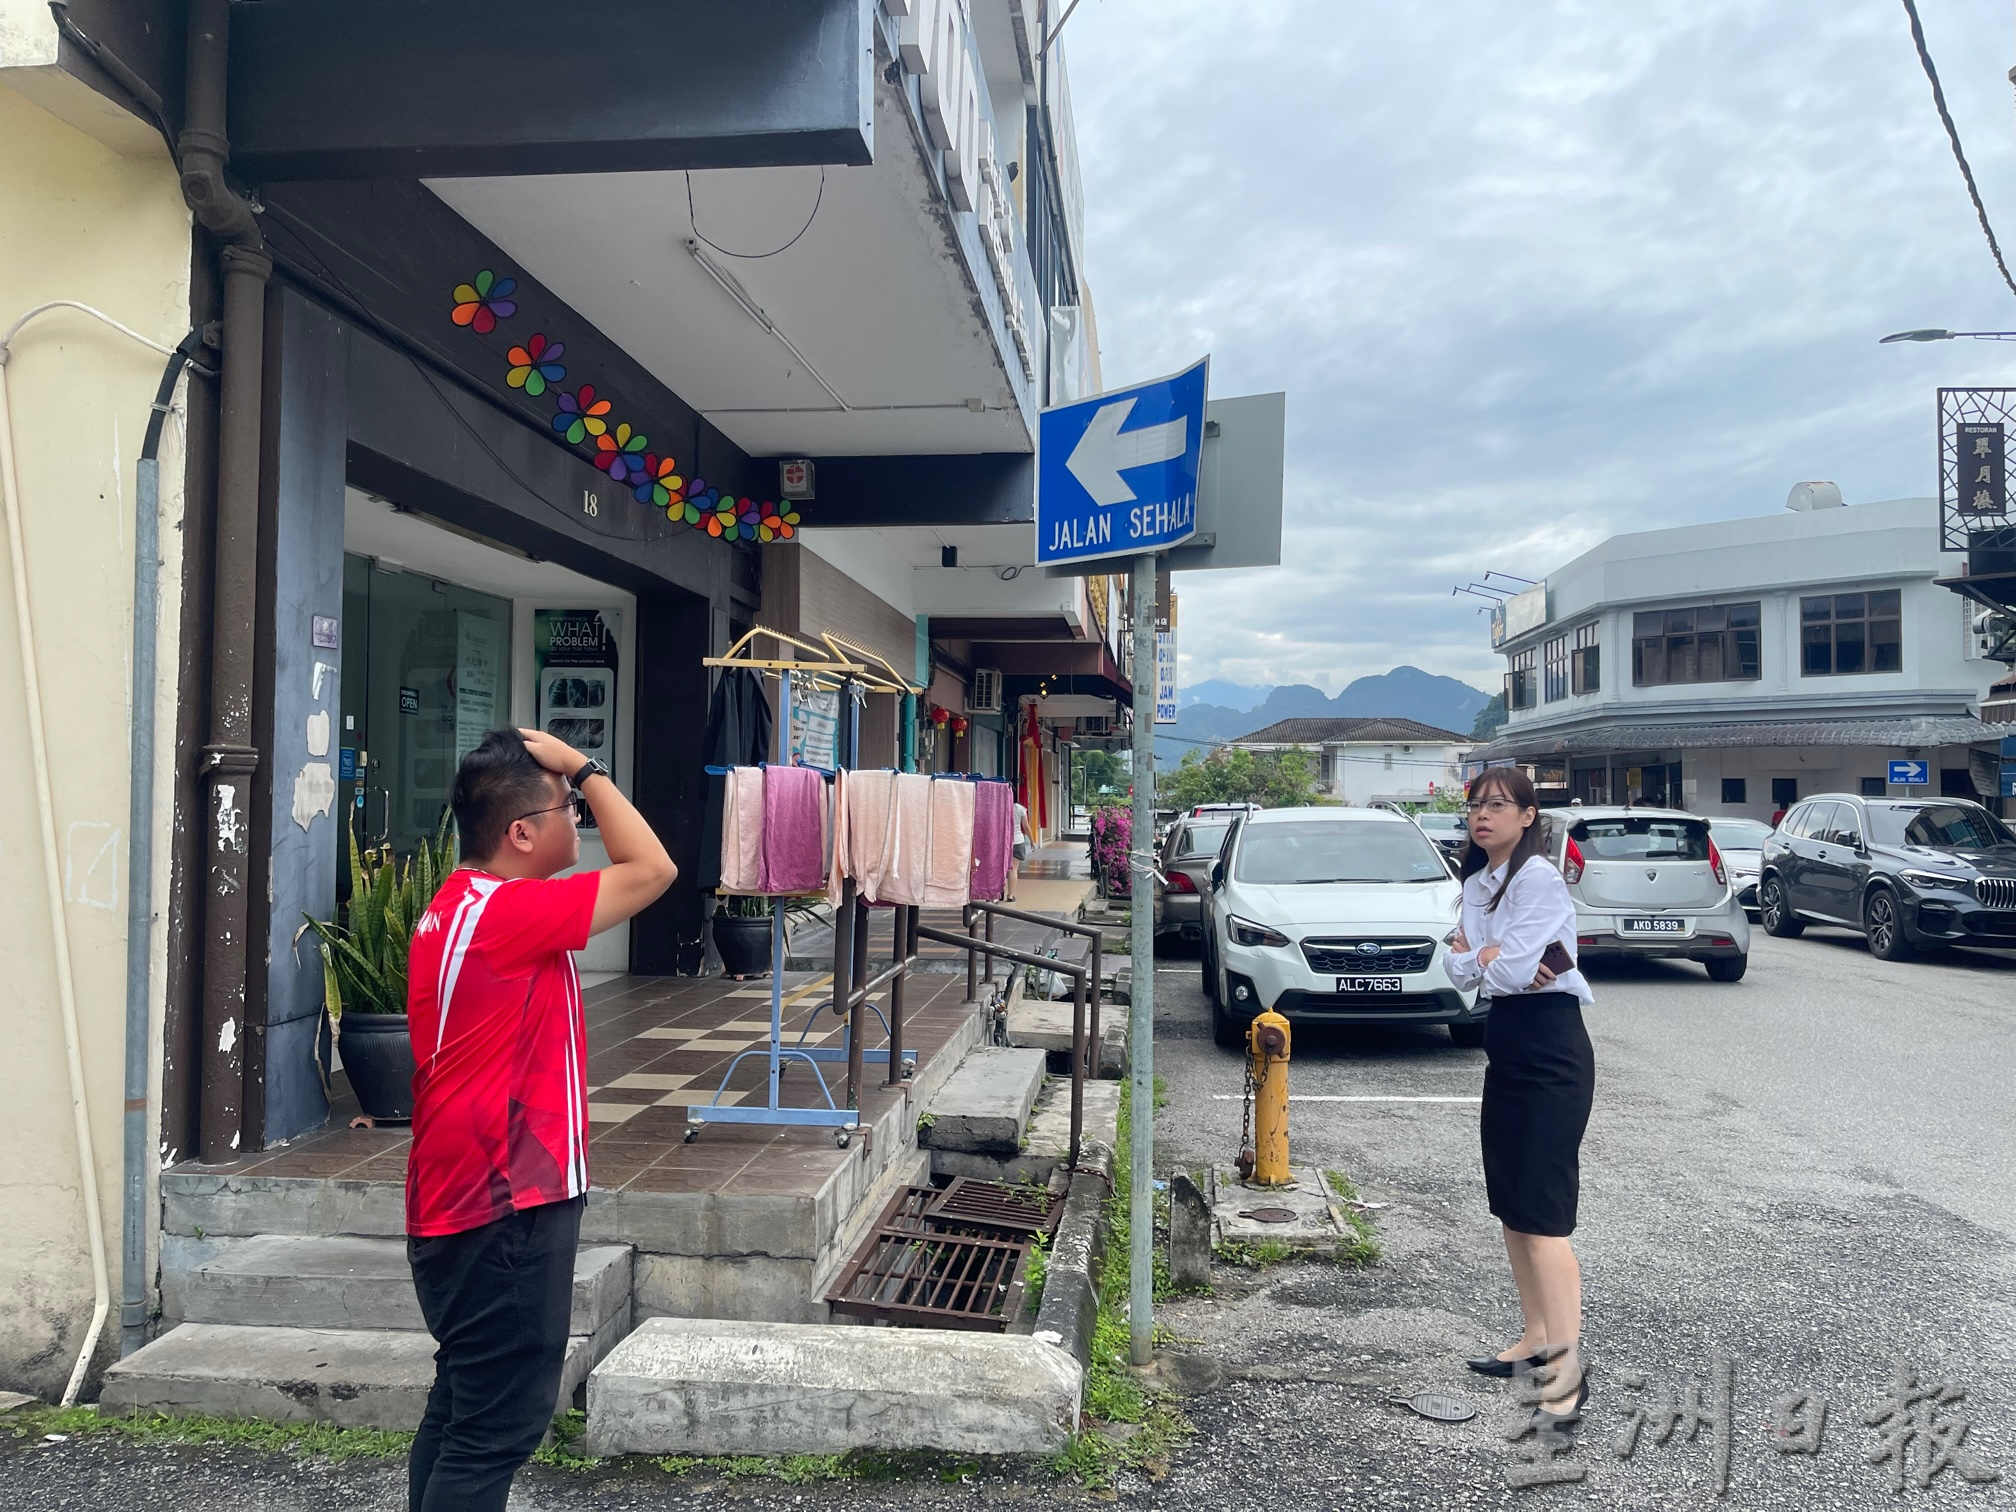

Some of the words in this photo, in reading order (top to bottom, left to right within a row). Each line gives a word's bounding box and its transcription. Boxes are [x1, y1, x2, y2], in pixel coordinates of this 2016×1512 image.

[583, 490, 597, 517] 18
[1049, 512, 1111, 551] JALAN
[1129, 492, 1190, 538] SEHALA
[549, 621, 601, 637] WHAT
[549, 636, 598, 646] PROBLEM
[1159, 685, 1173, 700] JAM
[401, 696, 418, 709] OPEN
[1157, 703, 1176, 719] POWER
[1633, 920, 1651, 930] AKD
[1653, 921, 1678, 931] 5839
